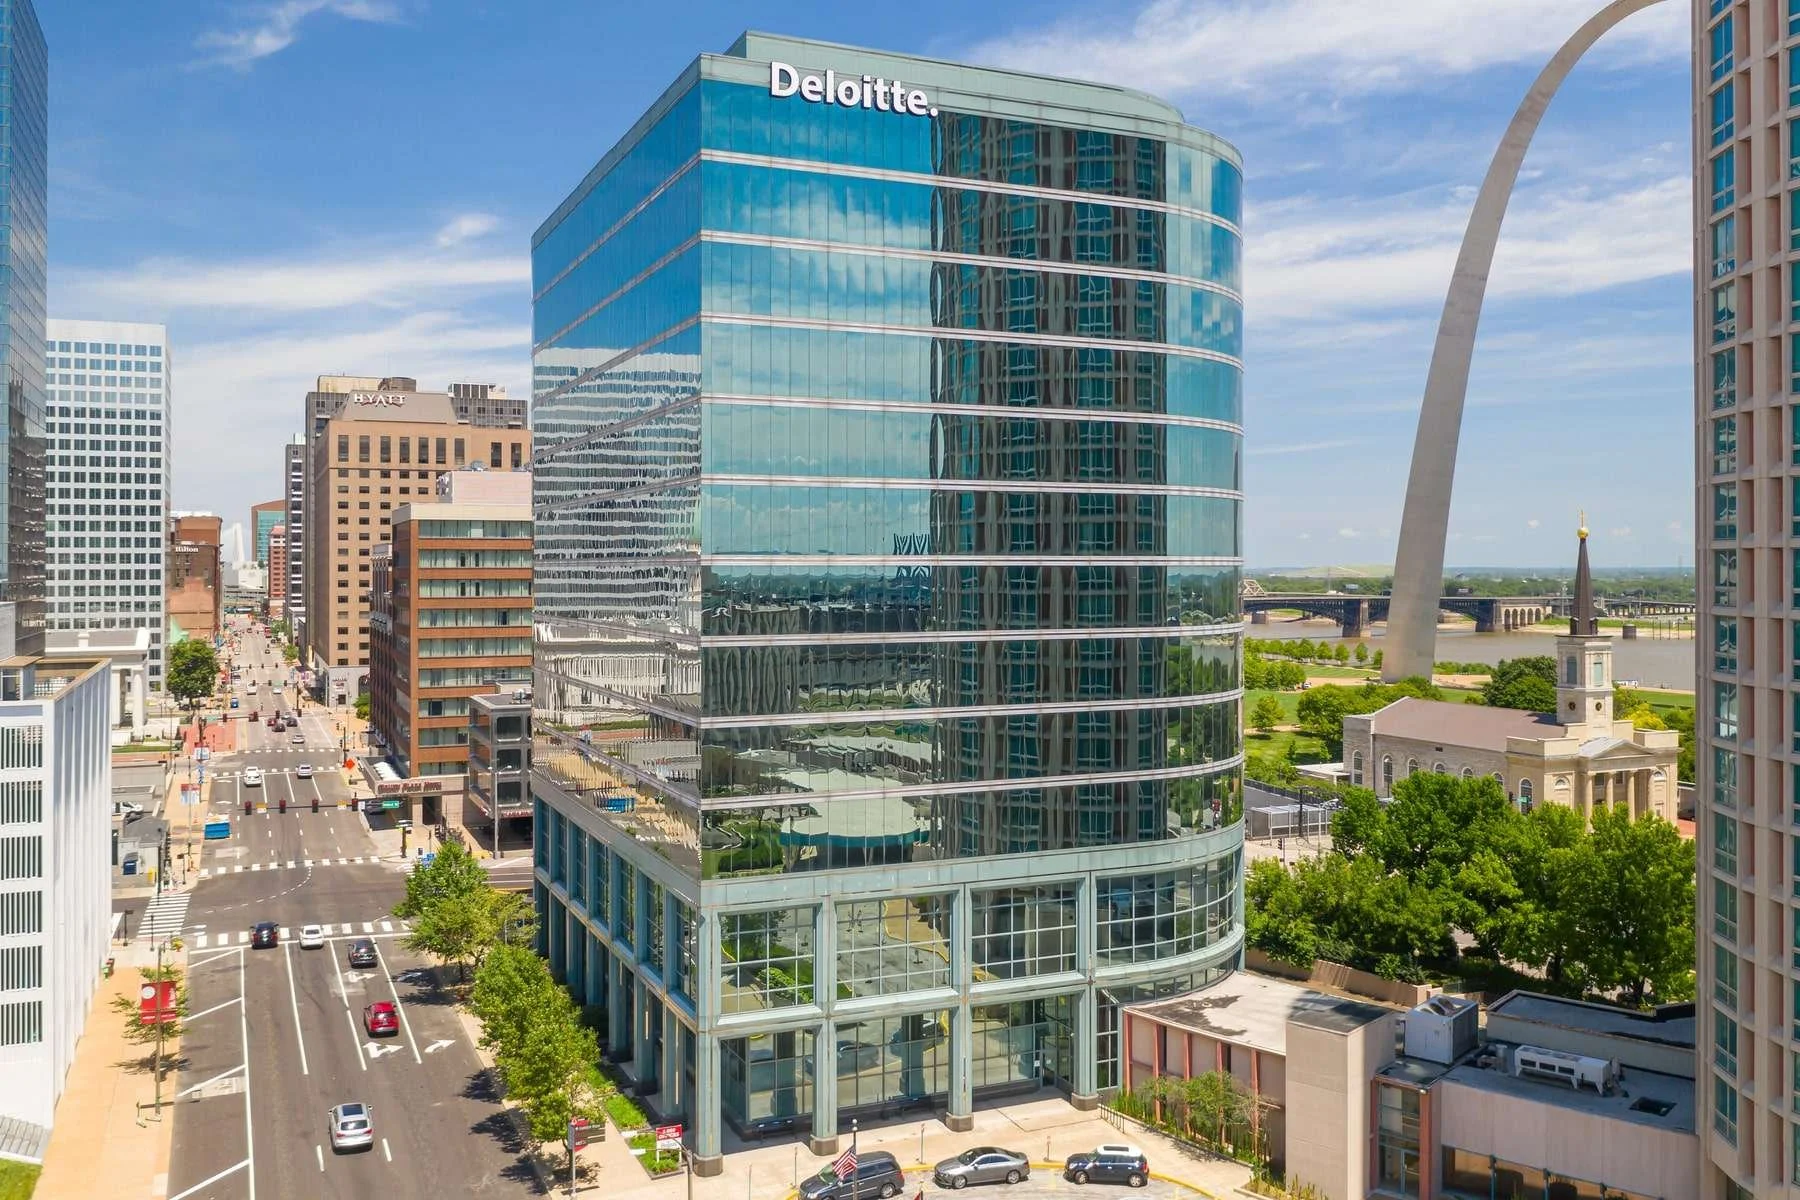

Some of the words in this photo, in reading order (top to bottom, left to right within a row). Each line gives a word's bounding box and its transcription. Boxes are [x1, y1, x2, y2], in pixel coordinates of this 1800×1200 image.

[770, 61, 939, 118] Deloitte.
[354, 393, 406, 407] HYATT
[175, 545, 199, 553] Hilton
